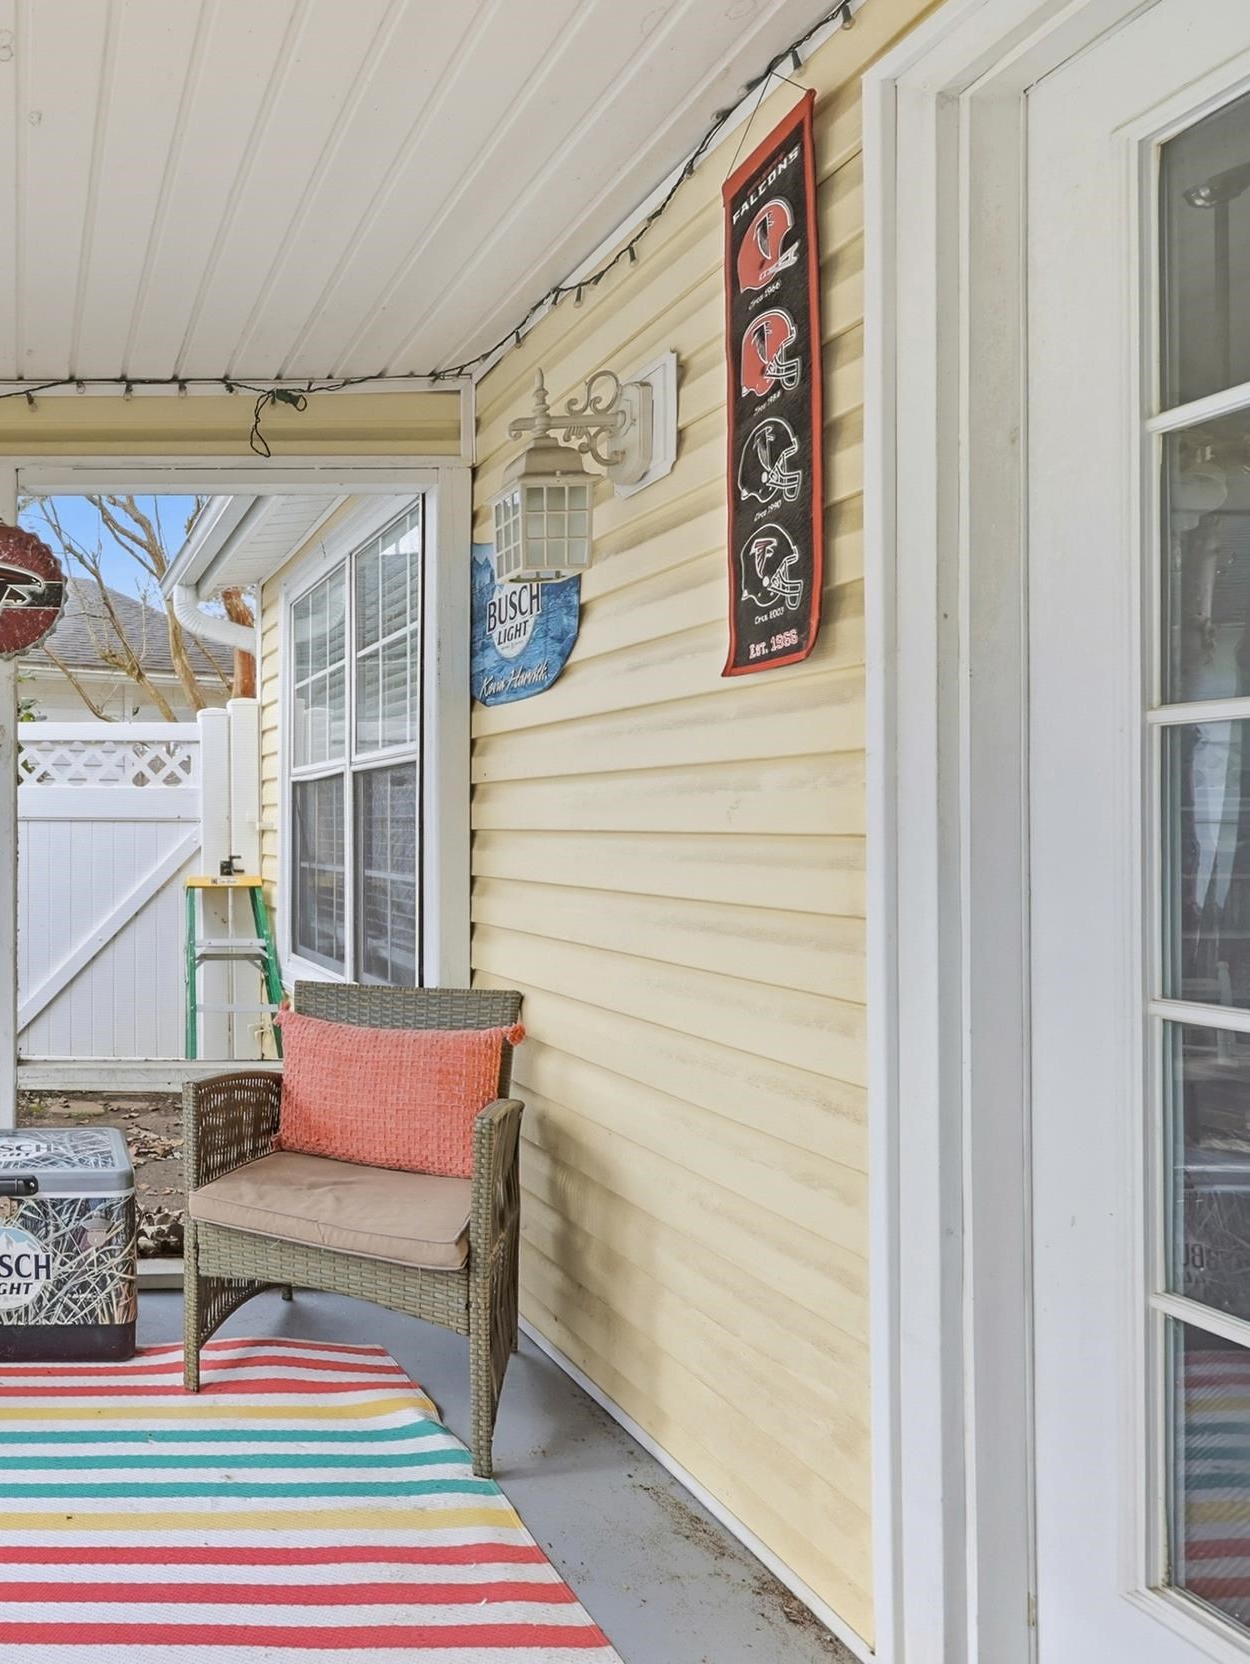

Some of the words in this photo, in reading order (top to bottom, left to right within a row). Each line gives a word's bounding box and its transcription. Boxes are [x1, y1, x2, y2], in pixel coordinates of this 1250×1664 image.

[732, 143, 800, 225] FALCONS
[487, 583, 540, 633] BUSCH
[497, 620, 529, 646] LIGHT
[770, 629, 799, 651] 1966
